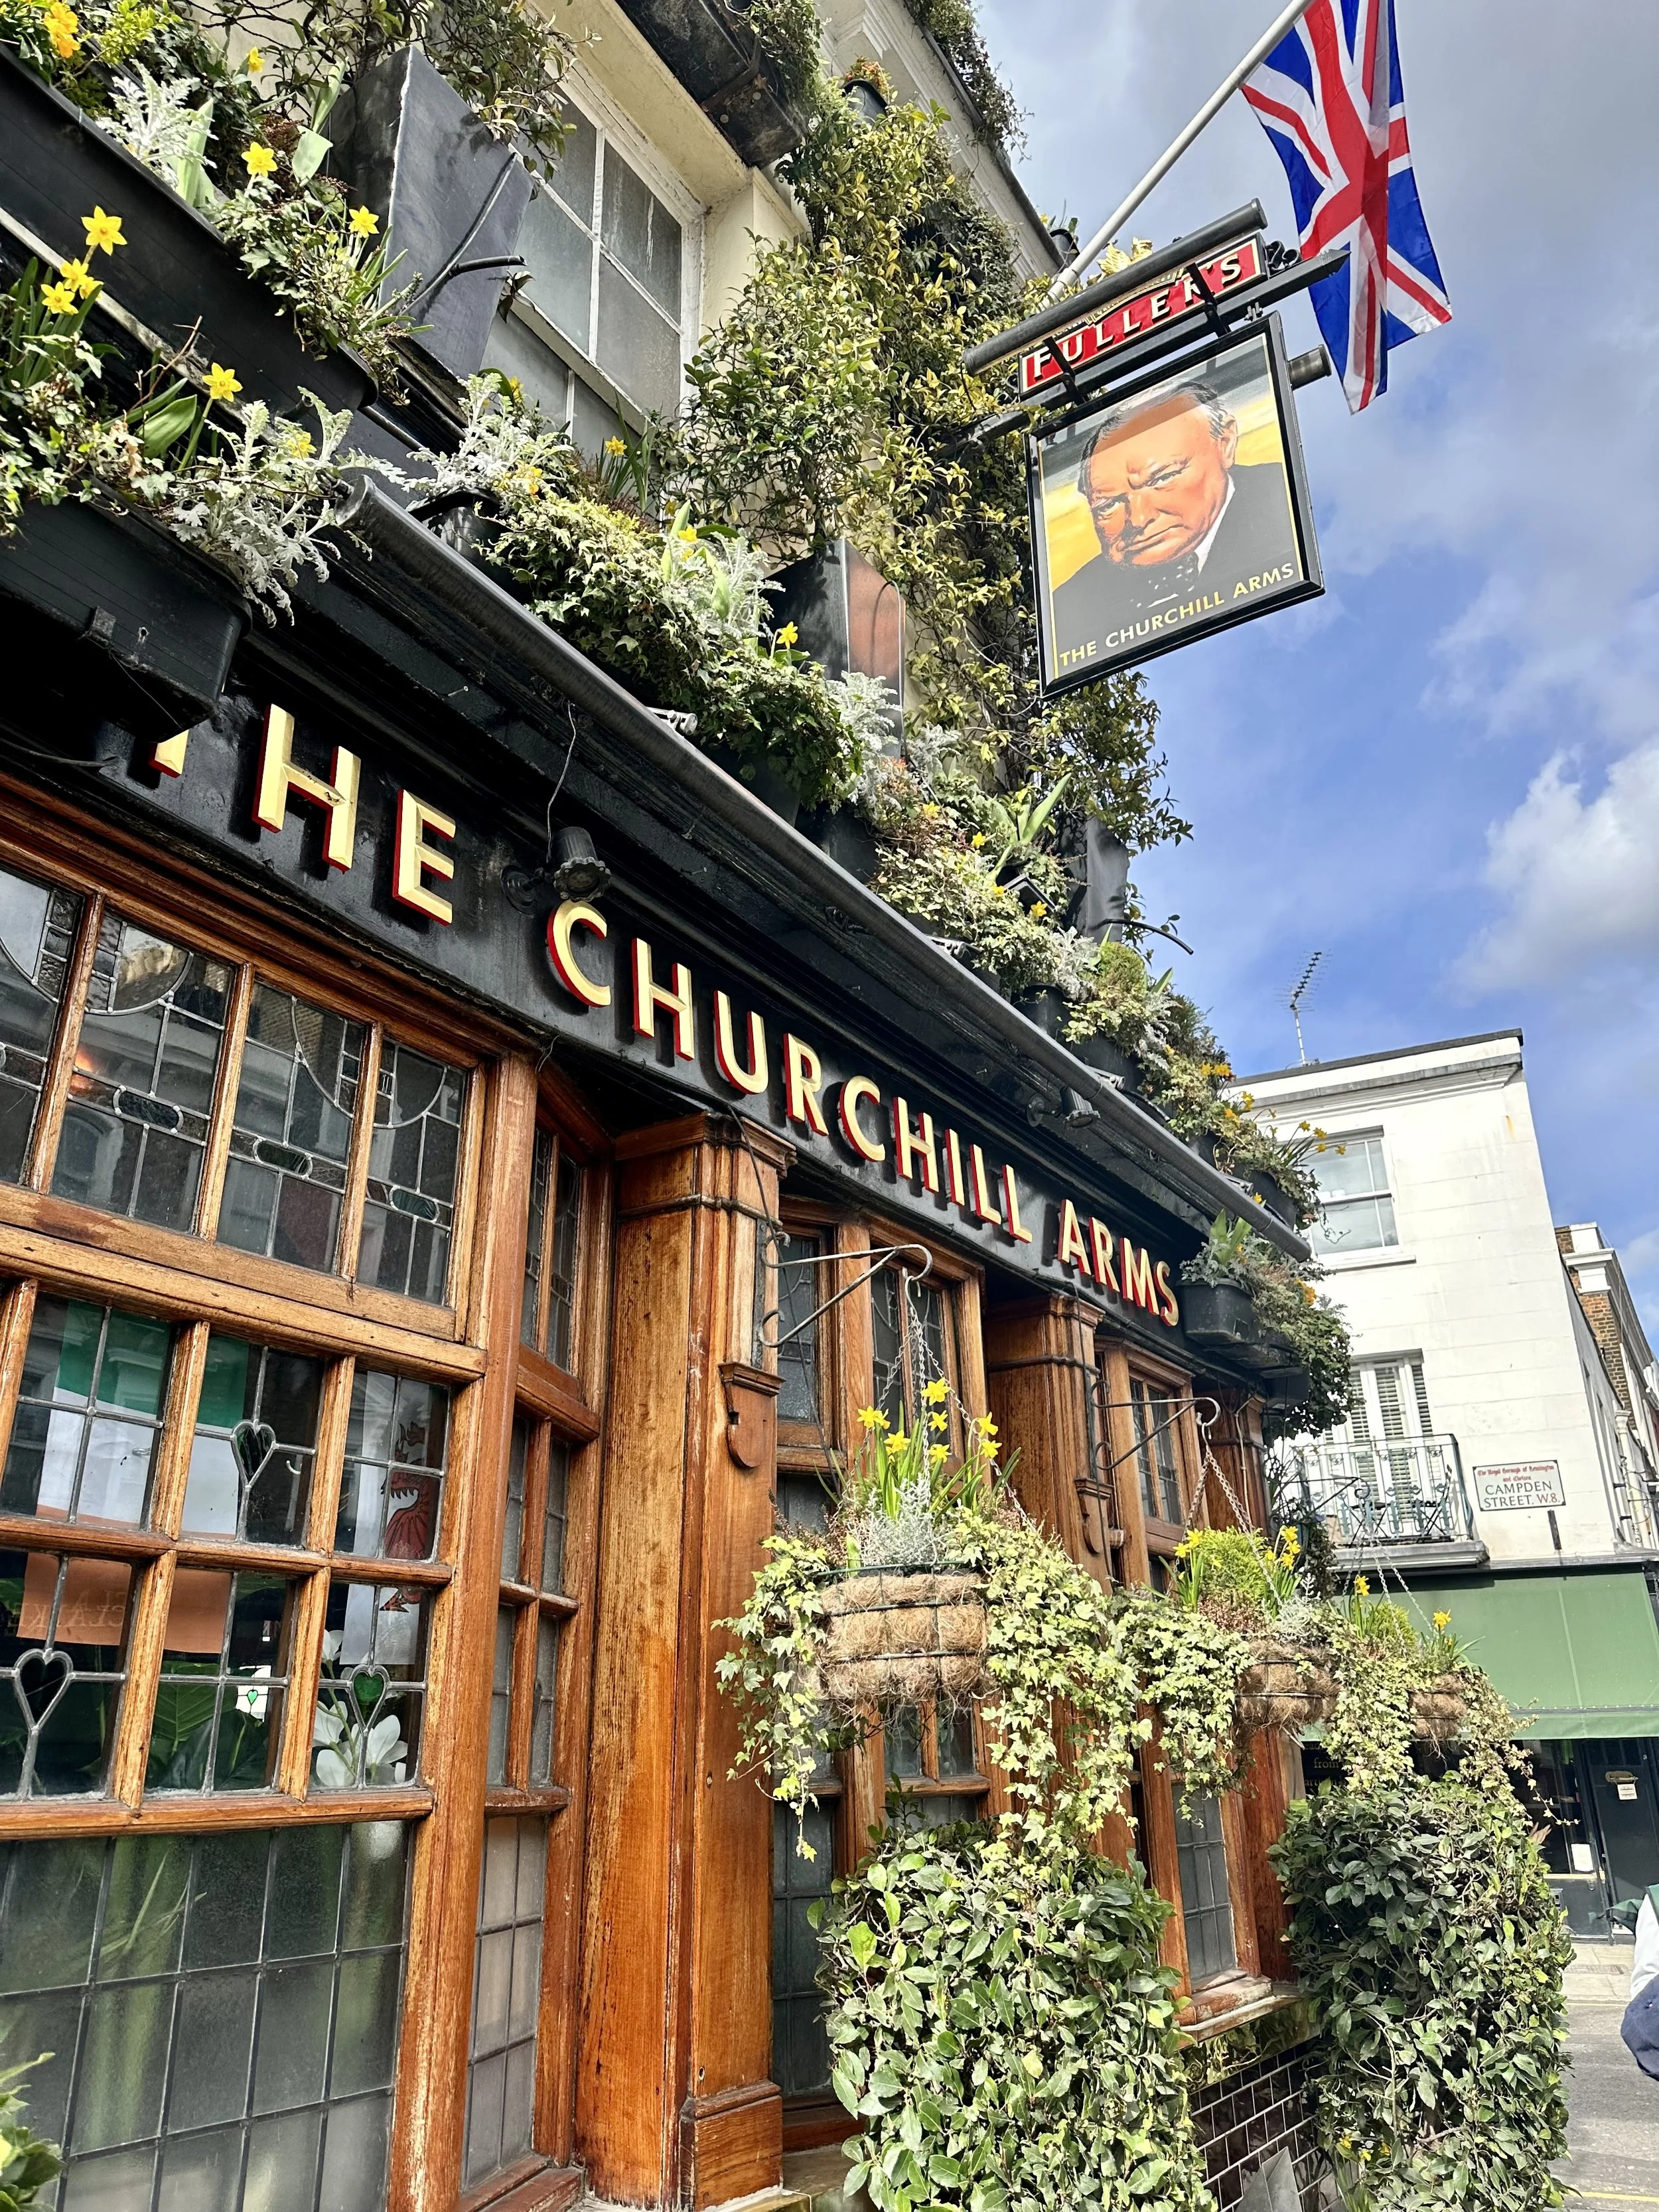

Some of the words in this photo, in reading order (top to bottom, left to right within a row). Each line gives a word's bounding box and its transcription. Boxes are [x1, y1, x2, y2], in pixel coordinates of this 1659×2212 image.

[1059, 640, 1098, 666] THE
[1105, 591, 1225, 648] CHURCHILL
[1232, 561, 1295, 599] ARMS
[148, 701, 457, 926] HE
[546, 899, 1033, 1244] CHURCHILL
[1056, 1198, 1180, 1327] ARMS
[1484, 1480, 1553, 1495] CAMPDEN
[1484, 1494, 1534, 1509] STREET.
[1536, 1492, 1561, 1505] W.8.
[1314, 1757, 1339, 1769] from
